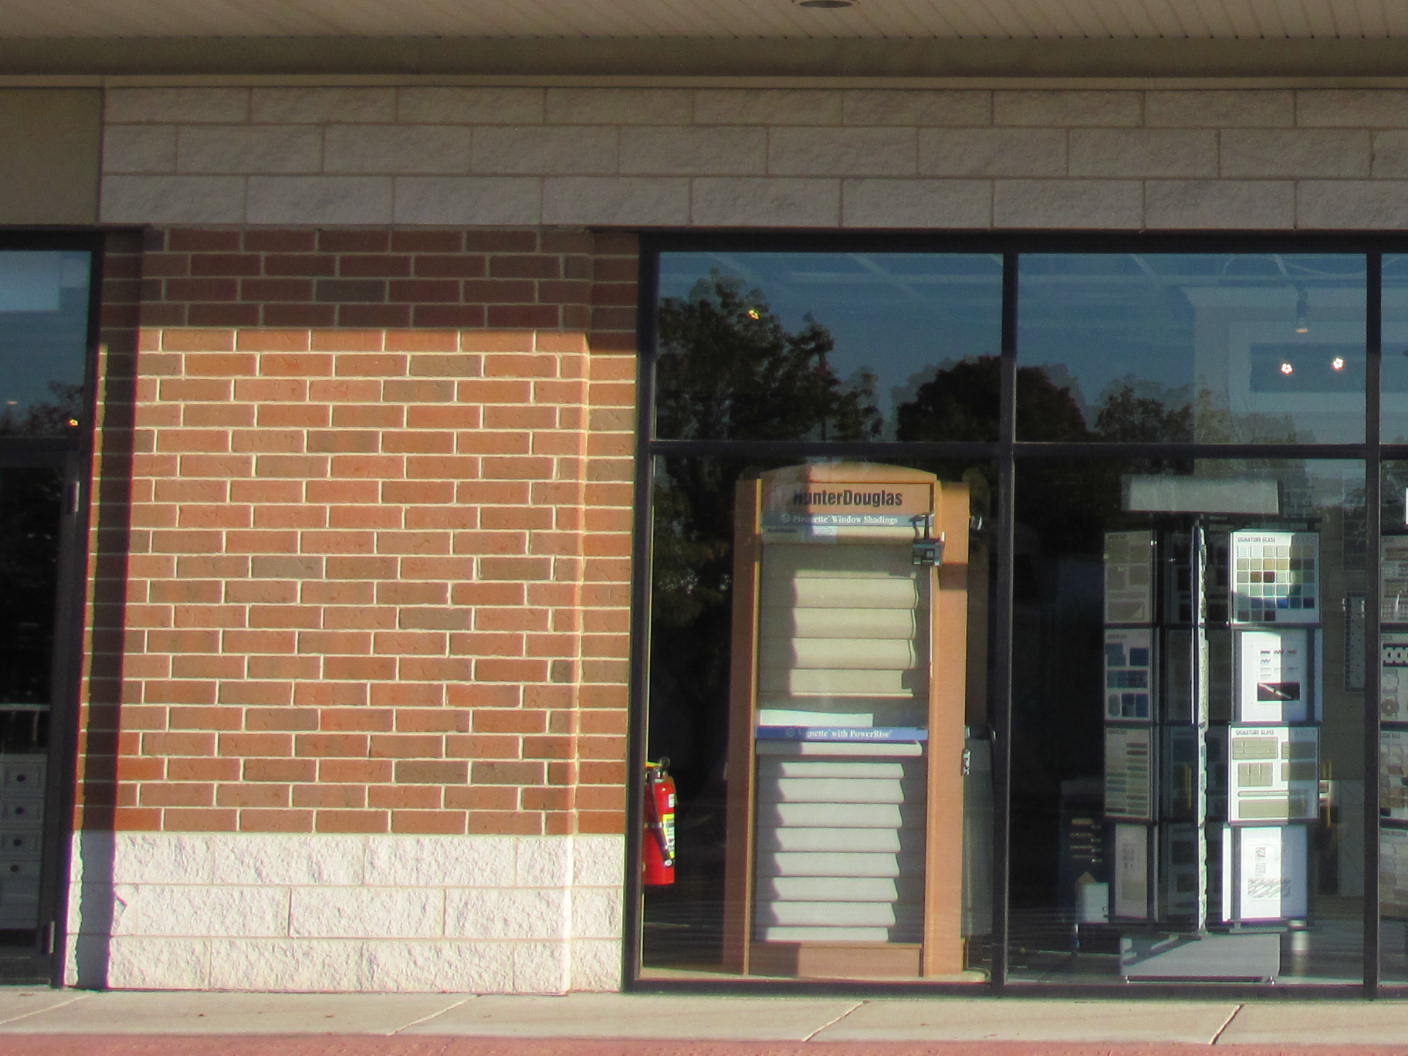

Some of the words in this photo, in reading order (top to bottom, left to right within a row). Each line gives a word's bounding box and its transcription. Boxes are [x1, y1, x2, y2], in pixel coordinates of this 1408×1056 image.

[830, 515, 861, 524] Window
[863, 515, 898, 526] Shadings
[832, 728, 848, 737] with
